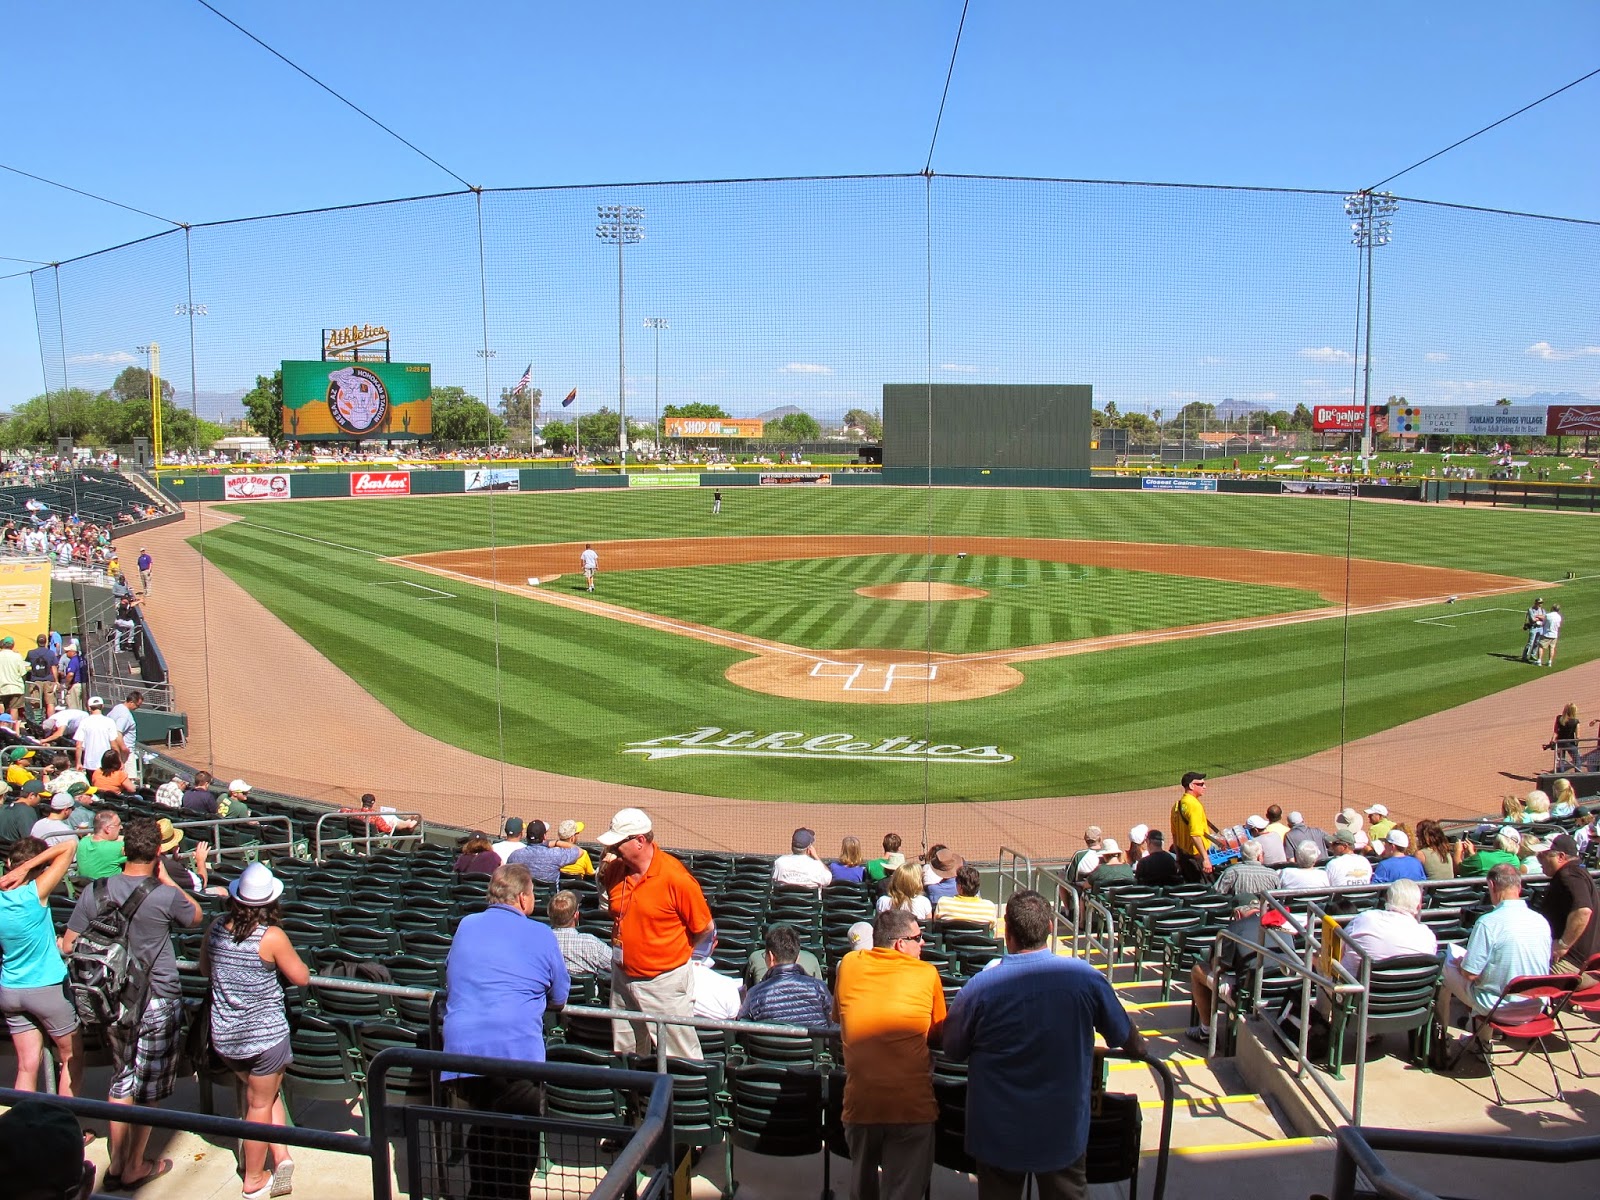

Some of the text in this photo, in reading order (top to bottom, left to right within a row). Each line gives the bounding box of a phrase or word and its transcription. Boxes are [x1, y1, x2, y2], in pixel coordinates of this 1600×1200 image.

[326, 324, 390, 354] Athletics
[330, 388, 338, 400] AZ
[357, 370, 386, 423] HOHOKAM STADIUM
[684, 420, 706, 434] SHOP
[708, 421, 720, 434] ON
[1469, 416, 1543, 424] SUNLAND SPRINGS VILLAGE
[227, 476, 248, 488] MAD
[622, 726, 1016, 761] Athletics
